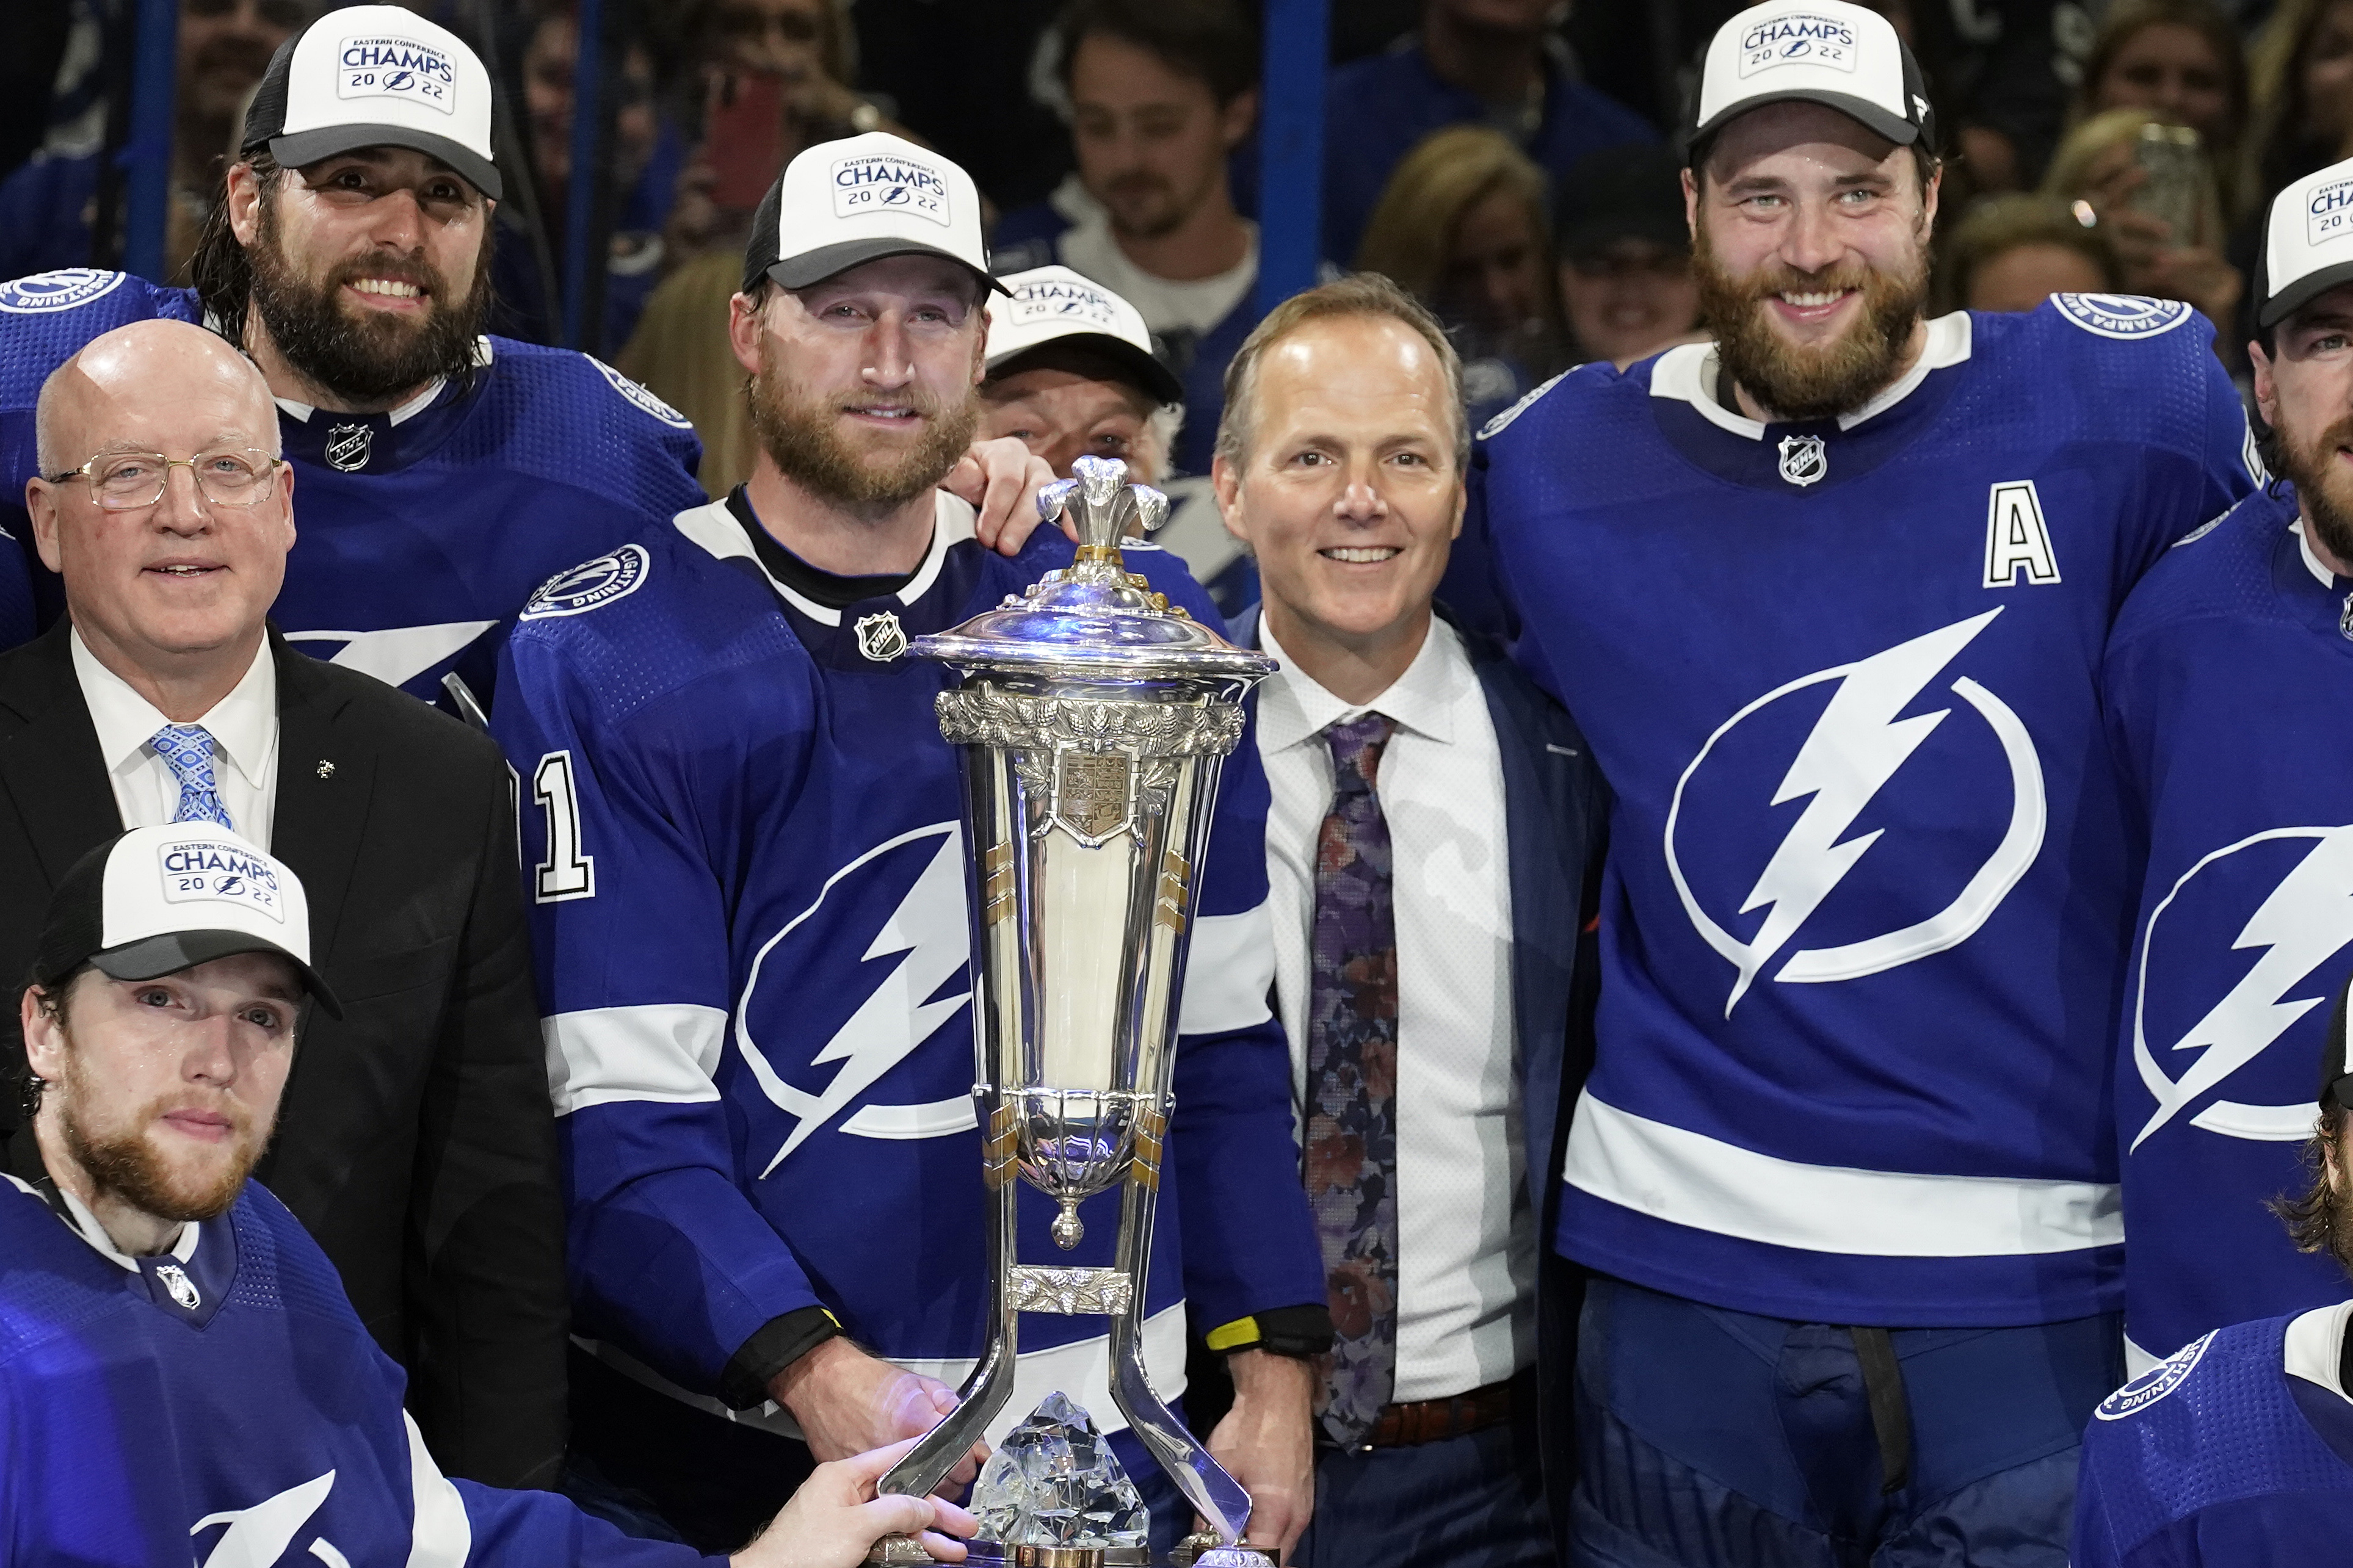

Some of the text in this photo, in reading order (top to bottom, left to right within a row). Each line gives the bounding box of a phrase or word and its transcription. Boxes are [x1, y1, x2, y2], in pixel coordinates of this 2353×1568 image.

[1745, 21, 1852, 49] CHAMPS
[394, 40, 446, 60] CONFERENCE
[1752, 45, 1842, 65] 20 22
[343, 46, 452, 82] CHAMPS
[351, 73, 443, 99] 20 22
[844, 157, 936, 175] EASTERN CONFERENCE
[836, 164, 944, 196] CHAMPS
[848, 190, 938, 212] 20 22
[2321, 215, 2341, 231] 20
[2092, 314, 2161, 331] TAMPA
[336, 436, 364, 460] NHL
[1790, 447, 1817, 474] NHL
[1982, 479, 2062, 589] A
[572, 551, 638, 607] LIGHTNING
[871, 624, 893, 653] NHL
[506, 750, 596, 905] 1
[217, 844, 269, 868] CONFERENCE
[165, 851, 277, 891] CHAMPS
[179, 877, 273, 907] 20 22
